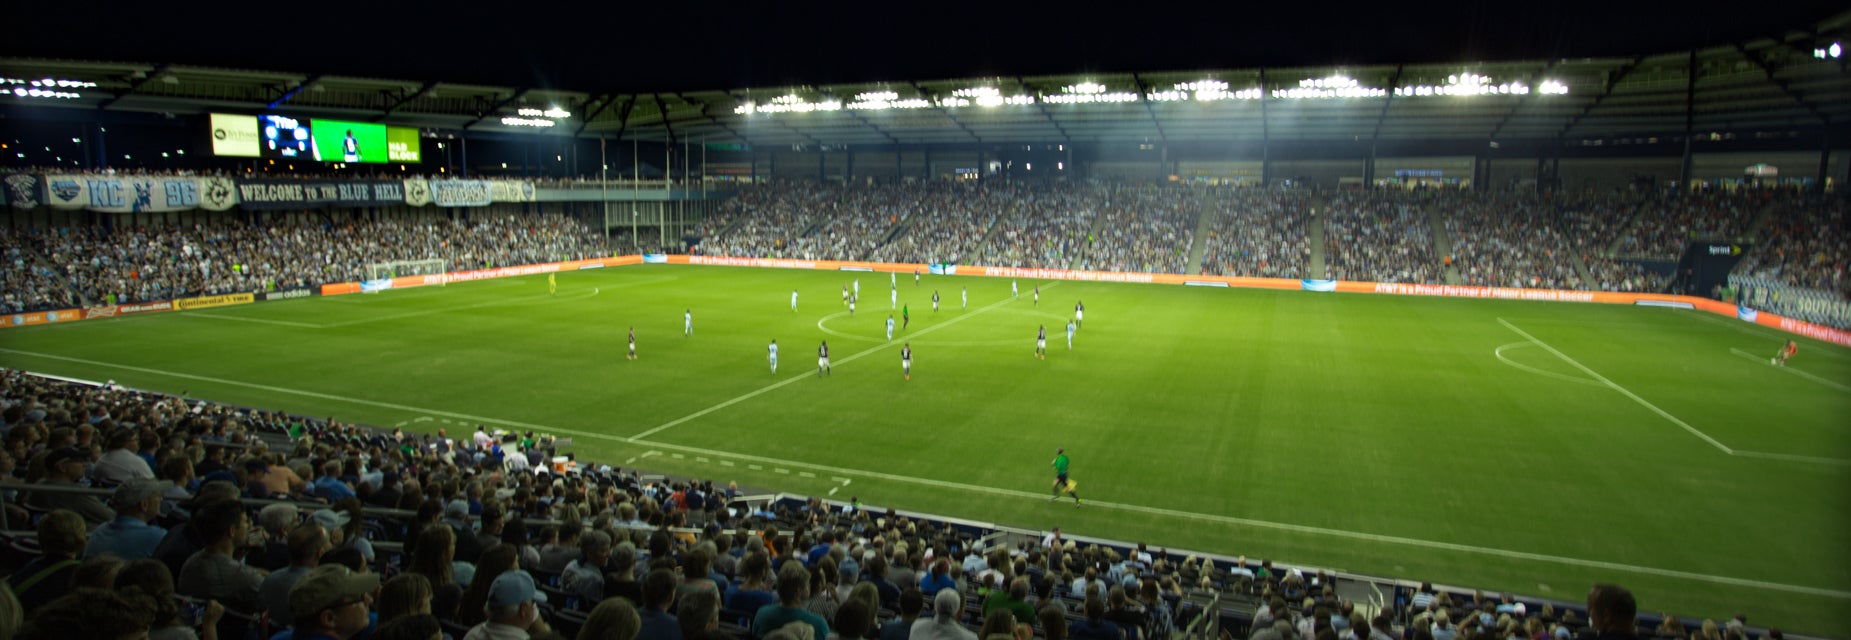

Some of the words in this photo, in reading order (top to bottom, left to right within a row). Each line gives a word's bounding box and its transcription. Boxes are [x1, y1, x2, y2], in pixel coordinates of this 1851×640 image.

[87, 180, 126, 207] KC
[164, 180, 198, 207] 96
[240, 184, 304, 202] WELCOME
[304, 187, 318, 200] TO
[320, 186, 338, 200] THE
[338, 184, 369, 200] BLUE
[374, 184, 402, 200] HELL
[1709, 244, 1730, 256] Sprint
[454, 270, 473, 281] Proud
[474, 269, 496, 280] Partner
[1017, 268, 1037, 278] Proud
[1039, 269, 1066, 279] Partner
[284, 289, 310, 298] adidas
[1376, 283, 1398, 293] AT&T
[1400, 284, 1406, 294] is
[1408, 286, 1414, 294] a
[1416, 284, 1442, 296] Proud
[1444, 285, 1478, 297] Partner
[1481, 287, 1492, 297] of
[1492, 288, 1519, 299] Major
[1520, 289, 1556, 300] League
[1559, 290, 1594, 302] Soccer
[178, 296, 224, 308] Continental
